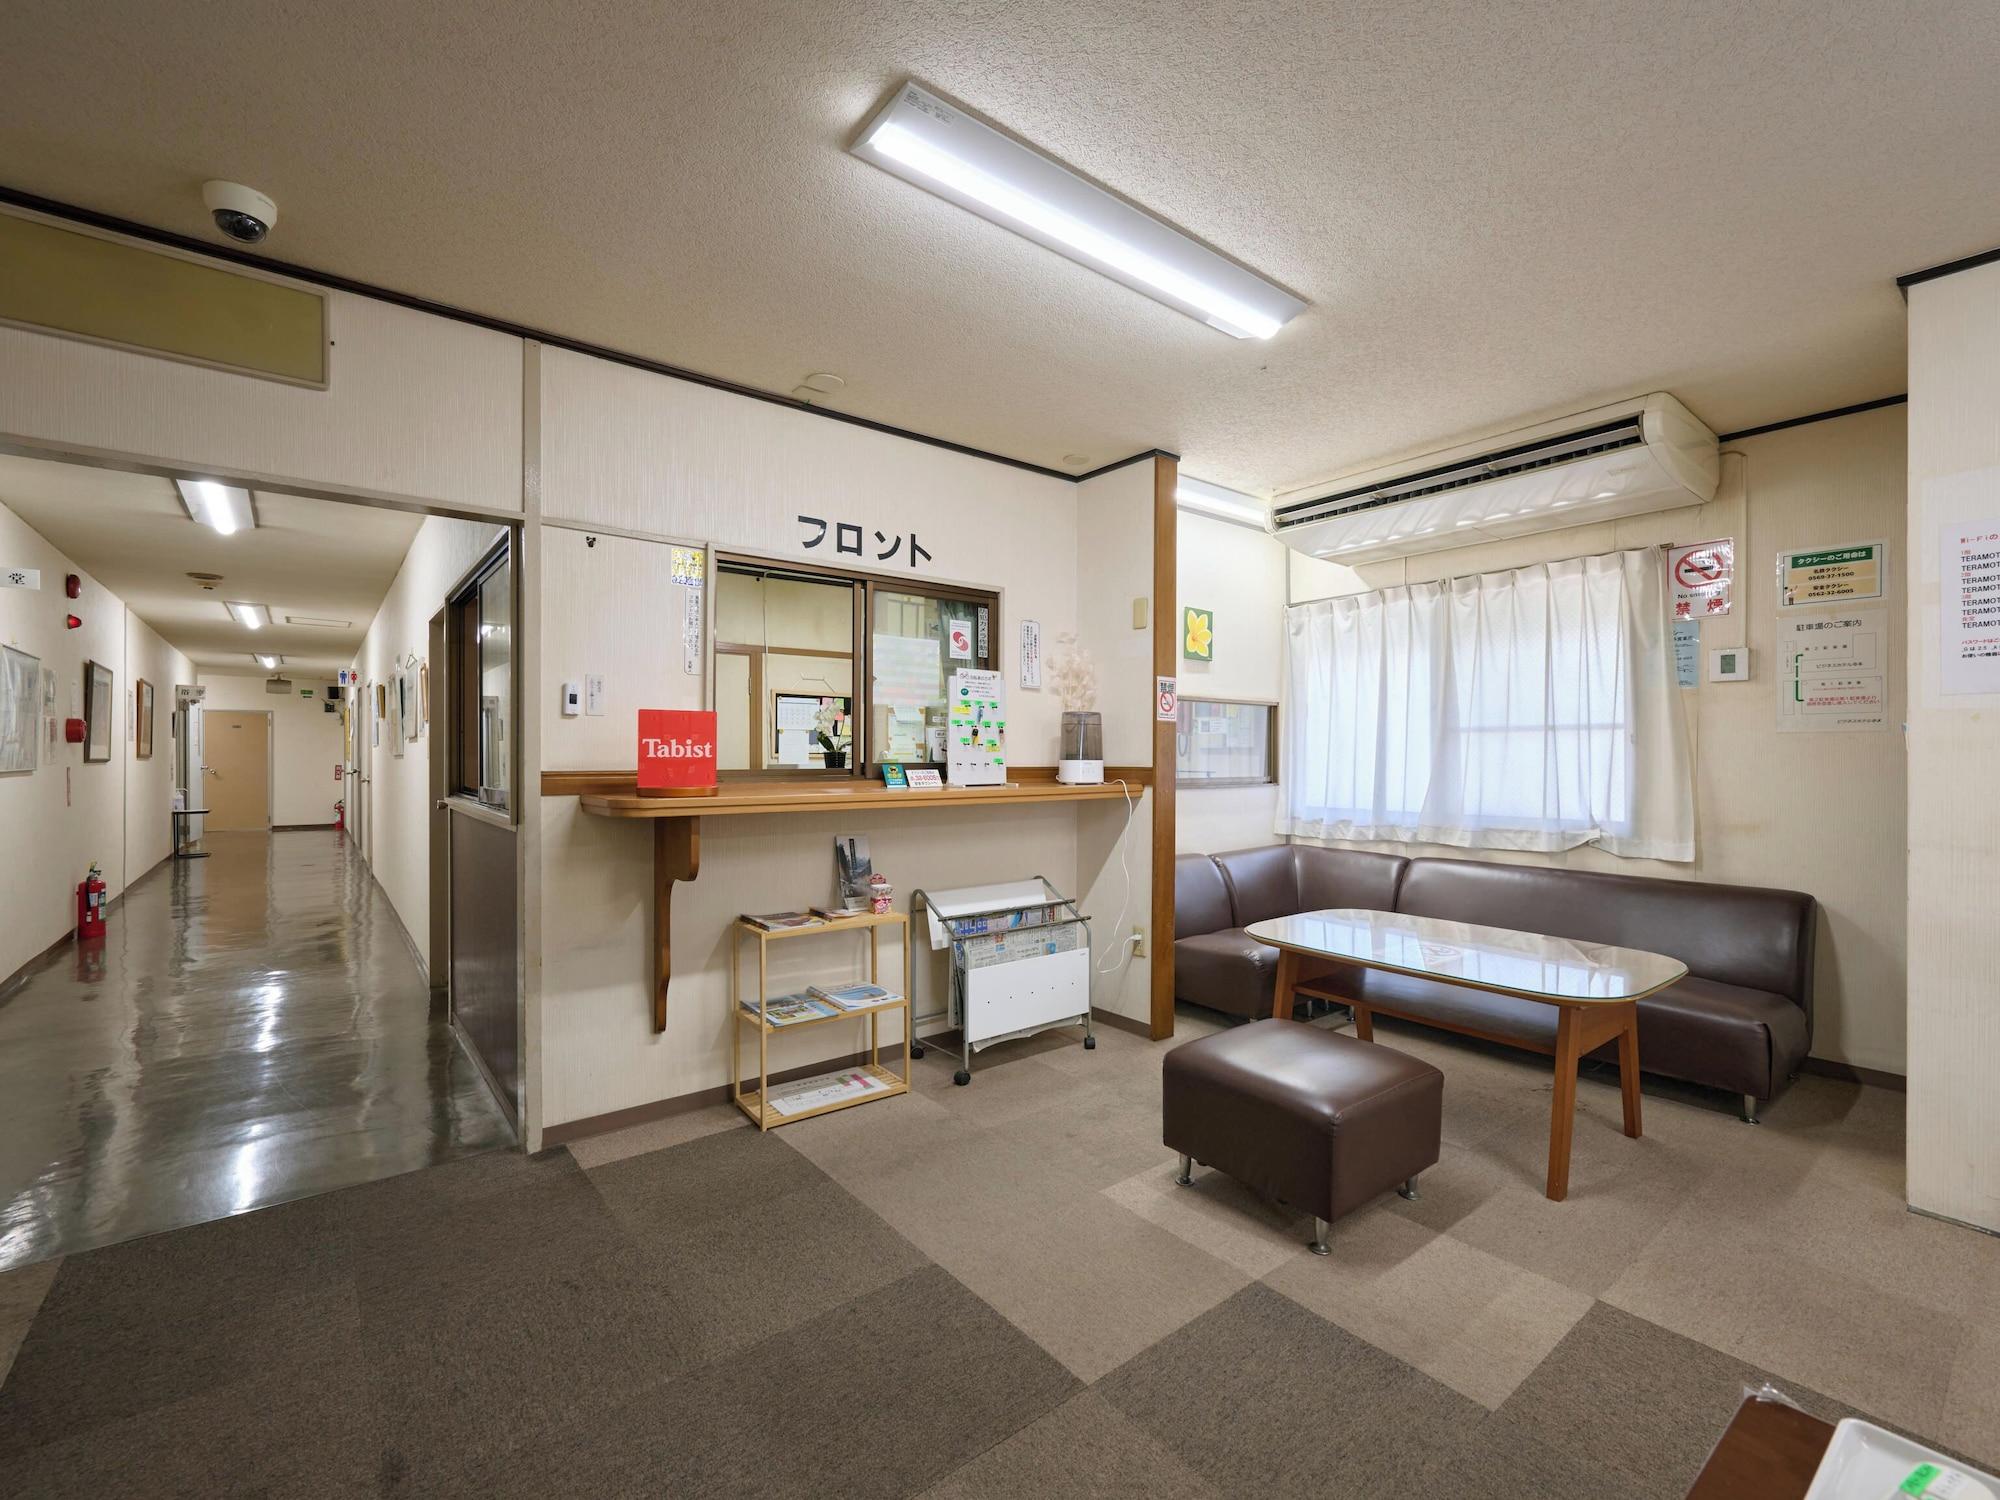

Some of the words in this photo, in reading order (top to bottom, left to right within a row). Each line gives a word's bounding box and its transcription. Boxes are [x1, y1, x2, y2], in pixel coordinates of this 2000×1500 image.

[798, 515, 932, 567] フロント
[1797, 550, 1866, 565] タクシーのご用命は
[1796, 619, 1862, 632] 駐車場のご案内
[642, 738, 712, 758] Tabist
